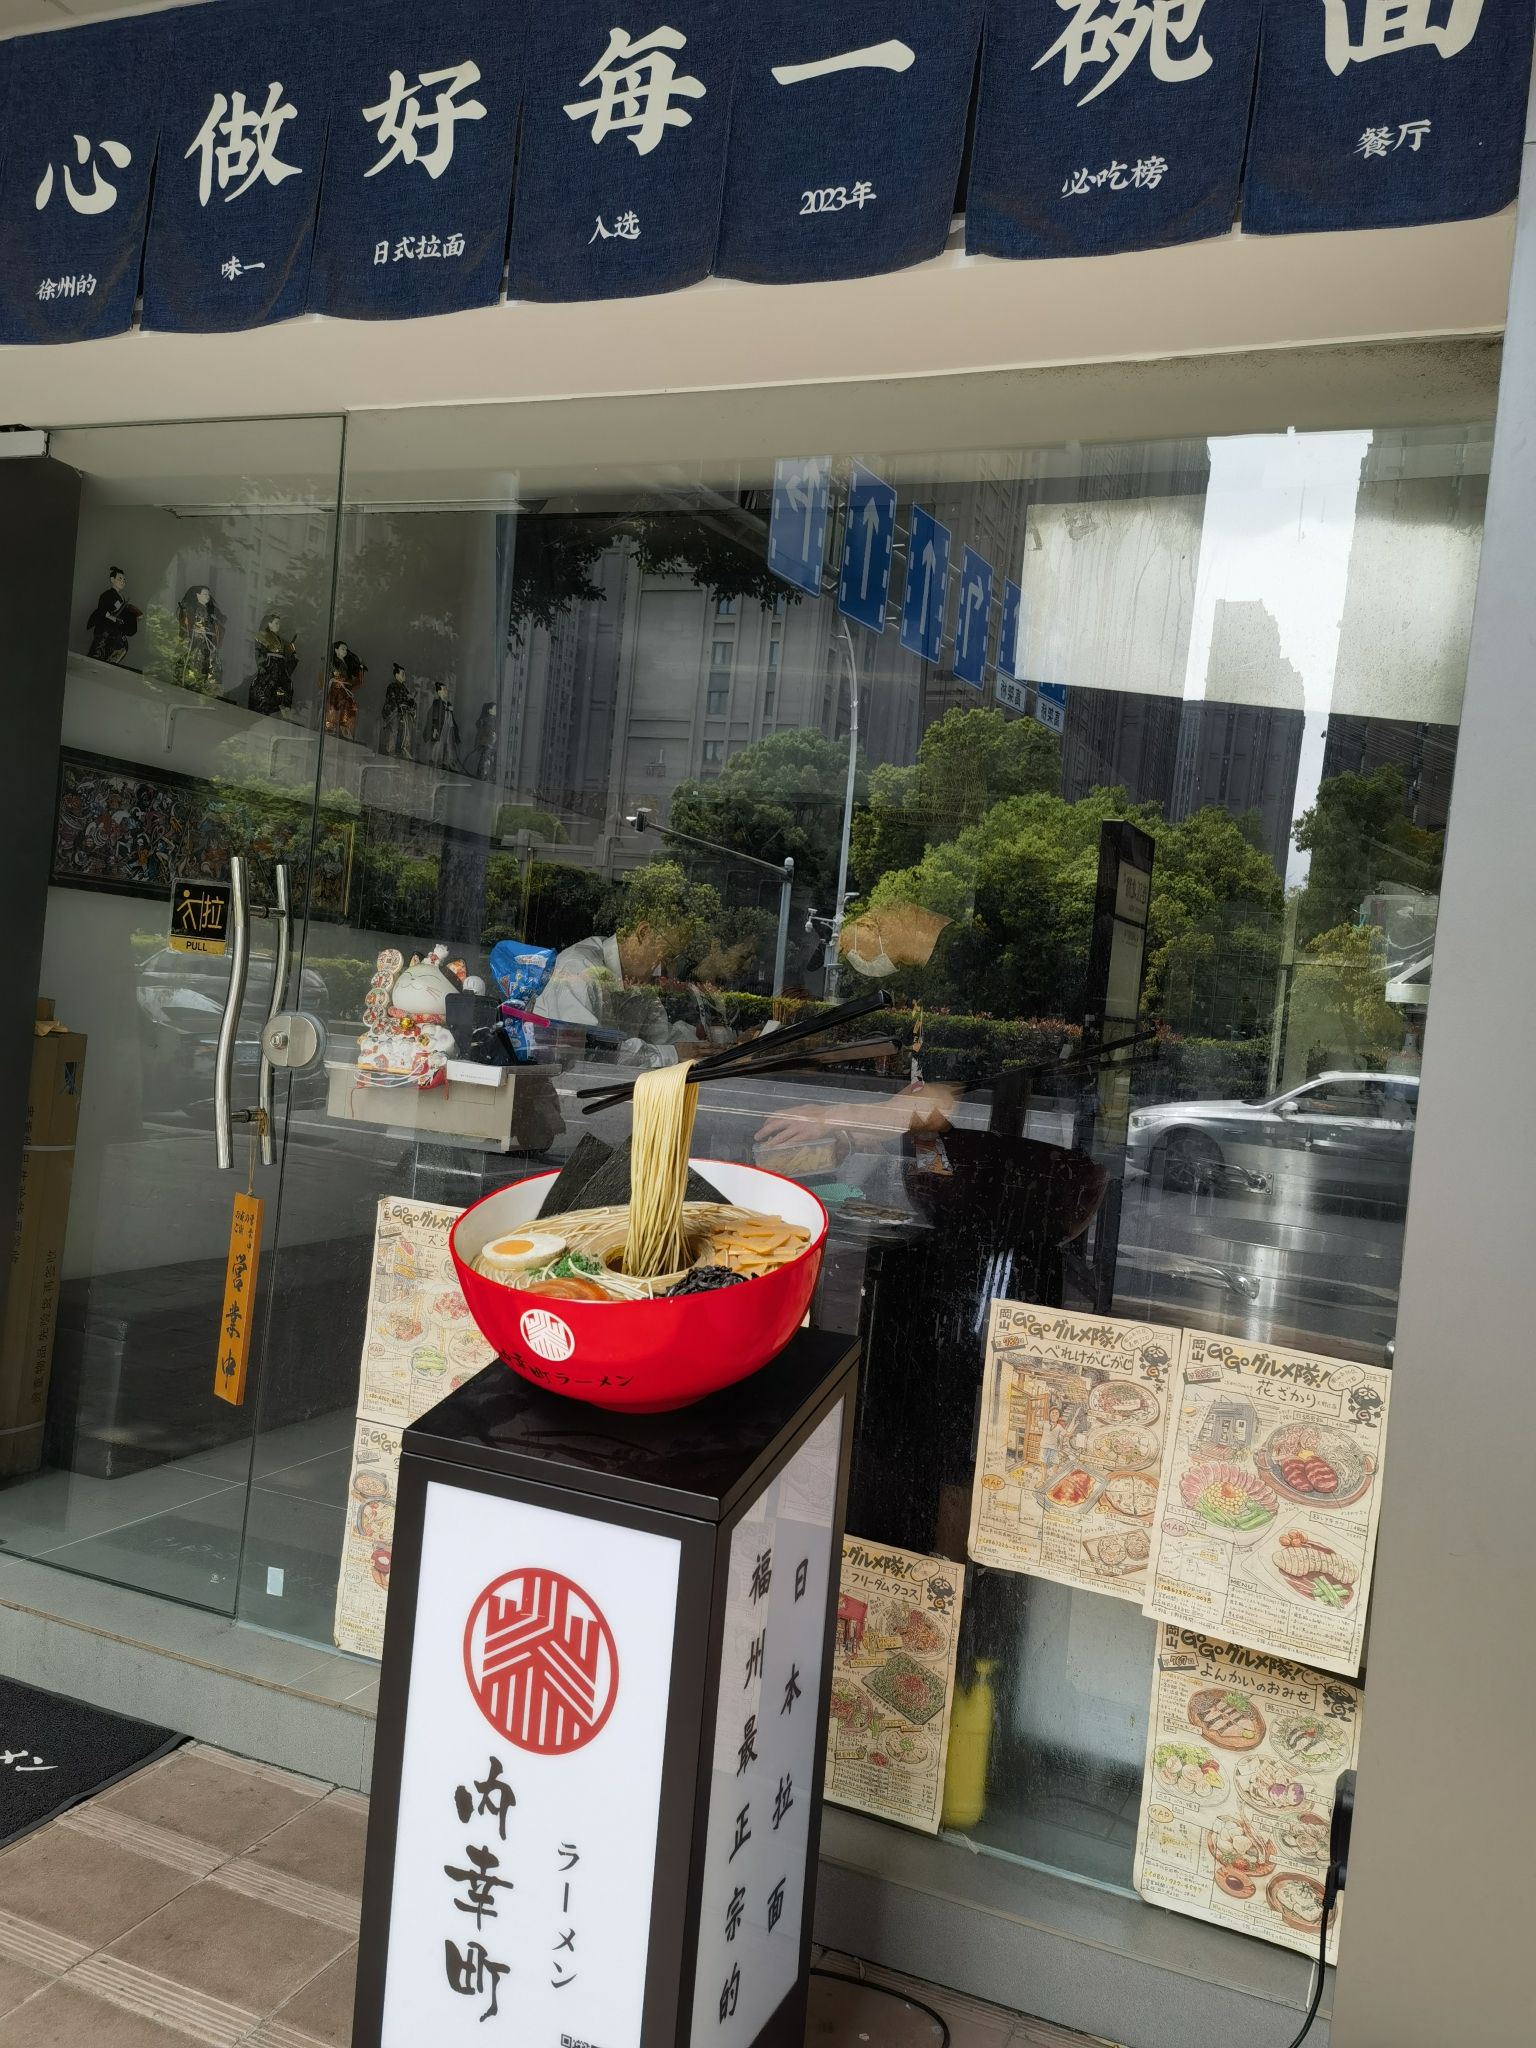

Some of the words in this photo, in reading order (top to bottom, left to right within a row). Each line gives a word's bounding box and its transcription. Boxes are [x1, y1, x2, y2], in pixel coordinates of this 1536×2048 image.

[37, 274, 97, 300] 徐州的
[222, 256, 265, 280] 味一
[374, 233, 465, 265] 日式拉面
[588, 211, 641, 243] 入选
[800, 181, 876, 214] 2023年
[1062, 156, 1168, 197] 必吃榜
[1356, 119, 1431, 158] 餐厅
[202, 894, 225, 928] 拉
[186, 941, 208, 951] PULL
[999, 1309, 1012, 1331] 岡山
[1191, 1339, 1206, 1363] 岡山
[1257, 1379, 1317, 1408] 花ざかり
[370, 1431, 401, 1455] GoGo
[1164, 1521, 1185, 1533] MAP
[1230, 1578, 1254, 1590] MENU
[1165, 1623, 1179, 1649] 岡山
[1201, 1663, 1311, 1705] よんかいのおみせ
[766, 1558, 809, 1935] 日本拉面
[718, 1549, 772, 2024] 福州最正宗的
[1150, 1808, 1170, 1819] MAP
[444, 1756, 517, 2023] 内幸町
[551, 1843, 580, 1990] ラーメン
